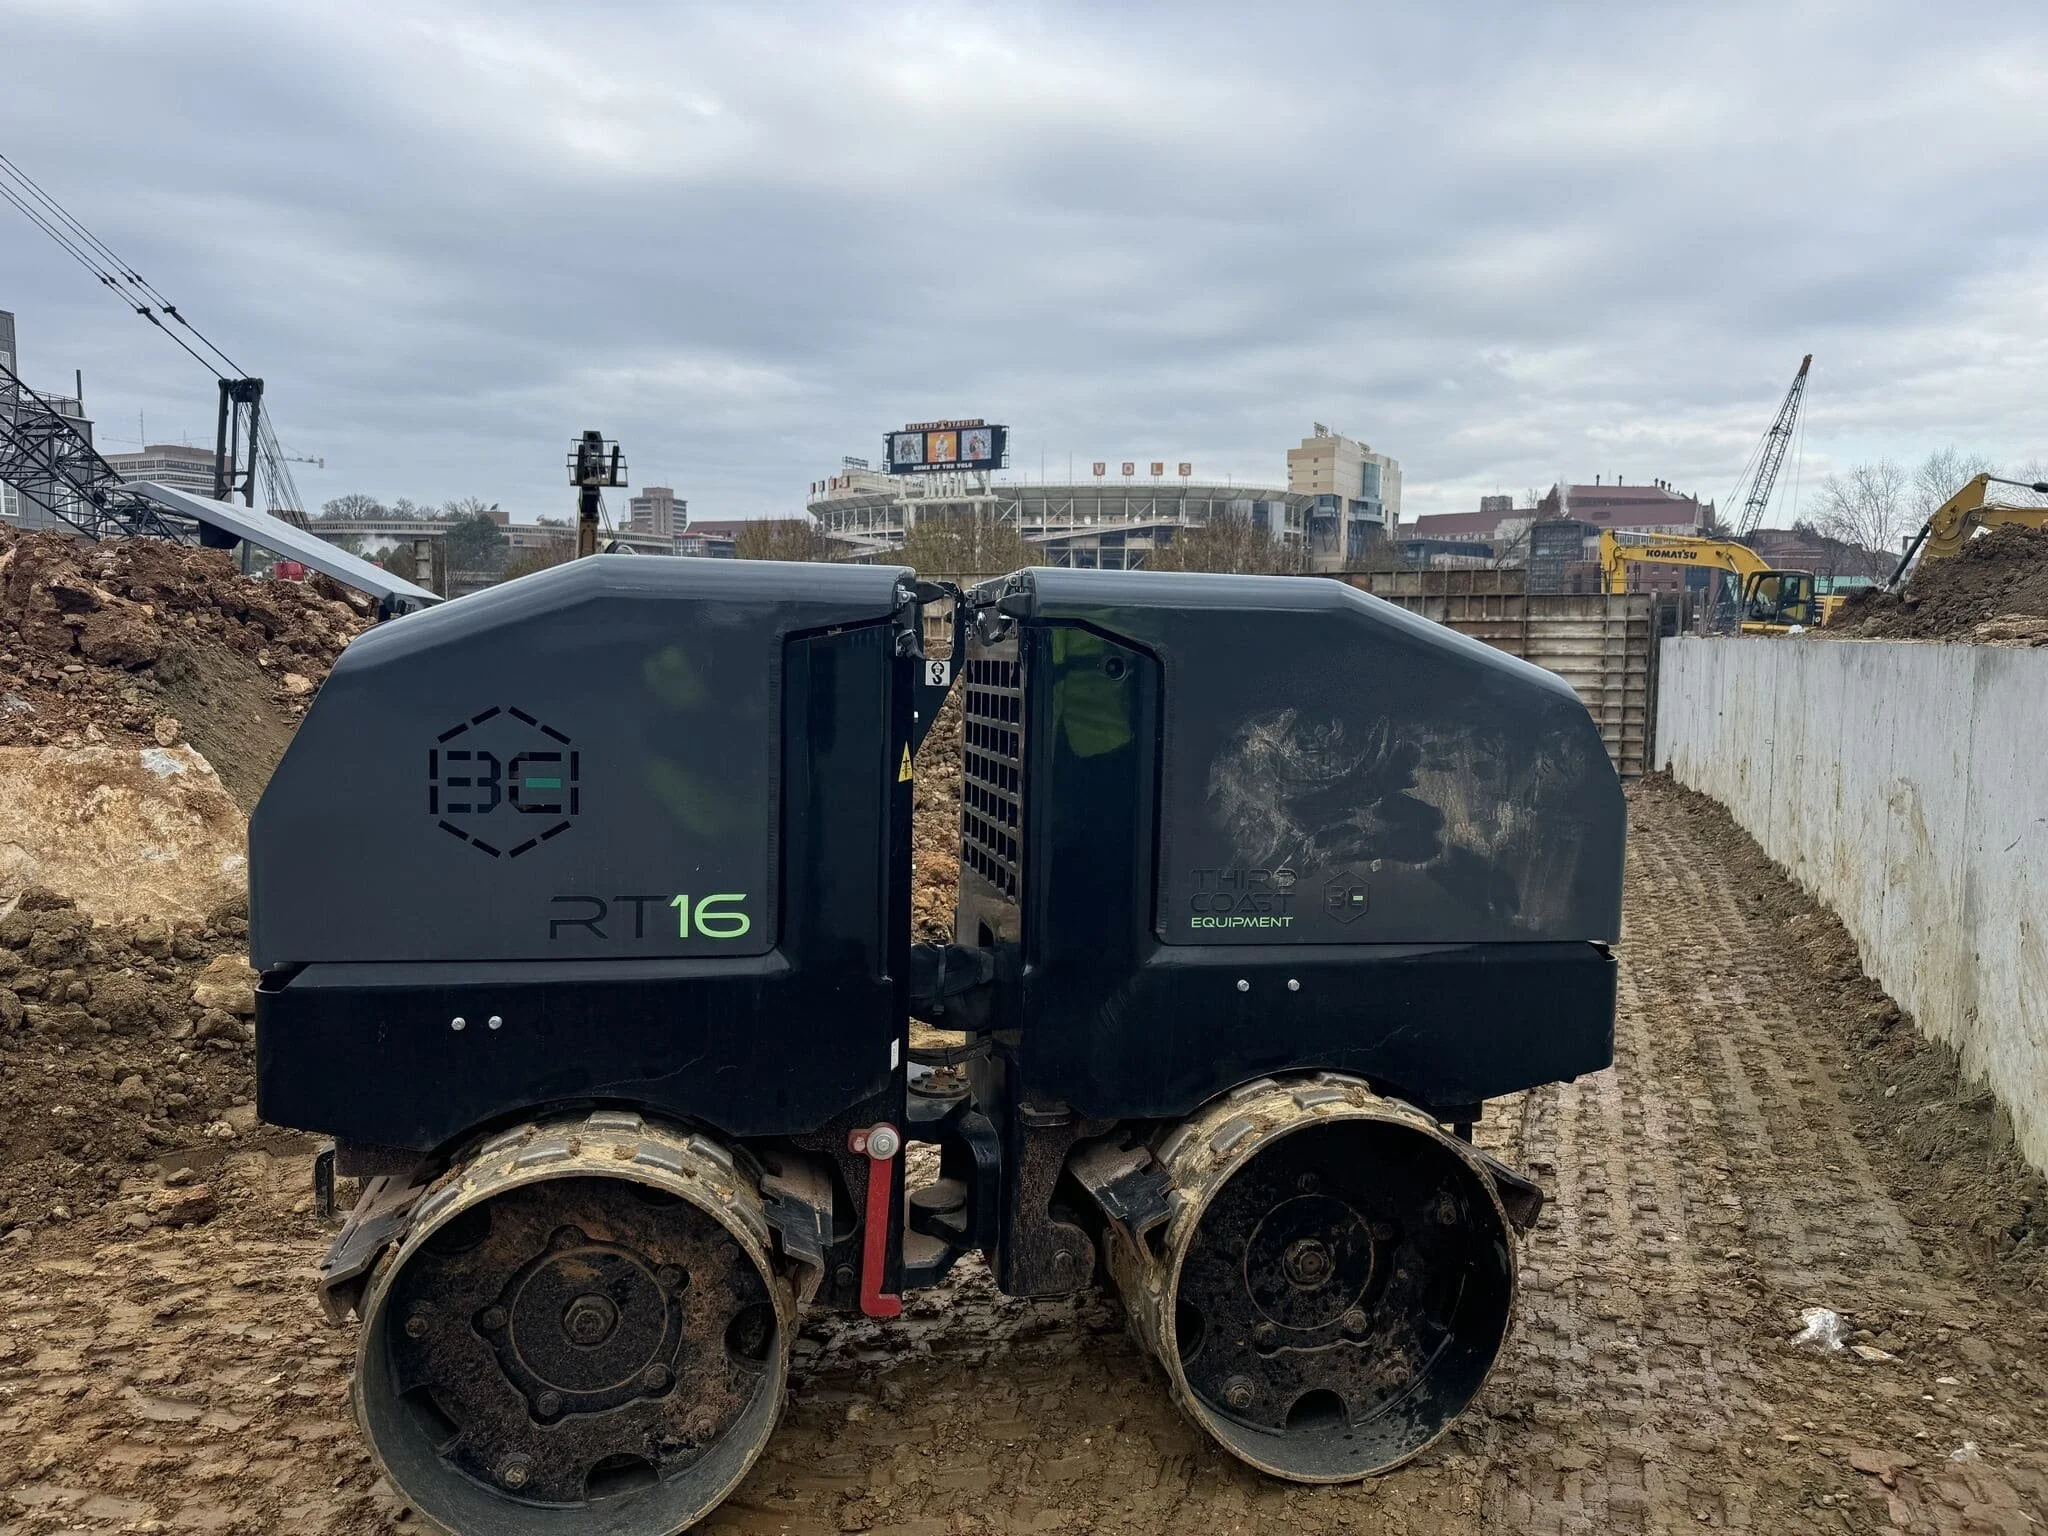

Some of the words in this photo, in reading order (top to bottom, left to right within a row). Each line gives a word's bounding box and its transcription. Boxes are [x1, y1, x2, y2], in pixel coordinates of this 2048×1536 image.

[1646, 549, 1697, 559] KOMATSU
[1190, 892, 1296, 913] COAST
[550, 893, 751, 939] RT16
[1191, 916, 1294, 928] EQUIPMENT
